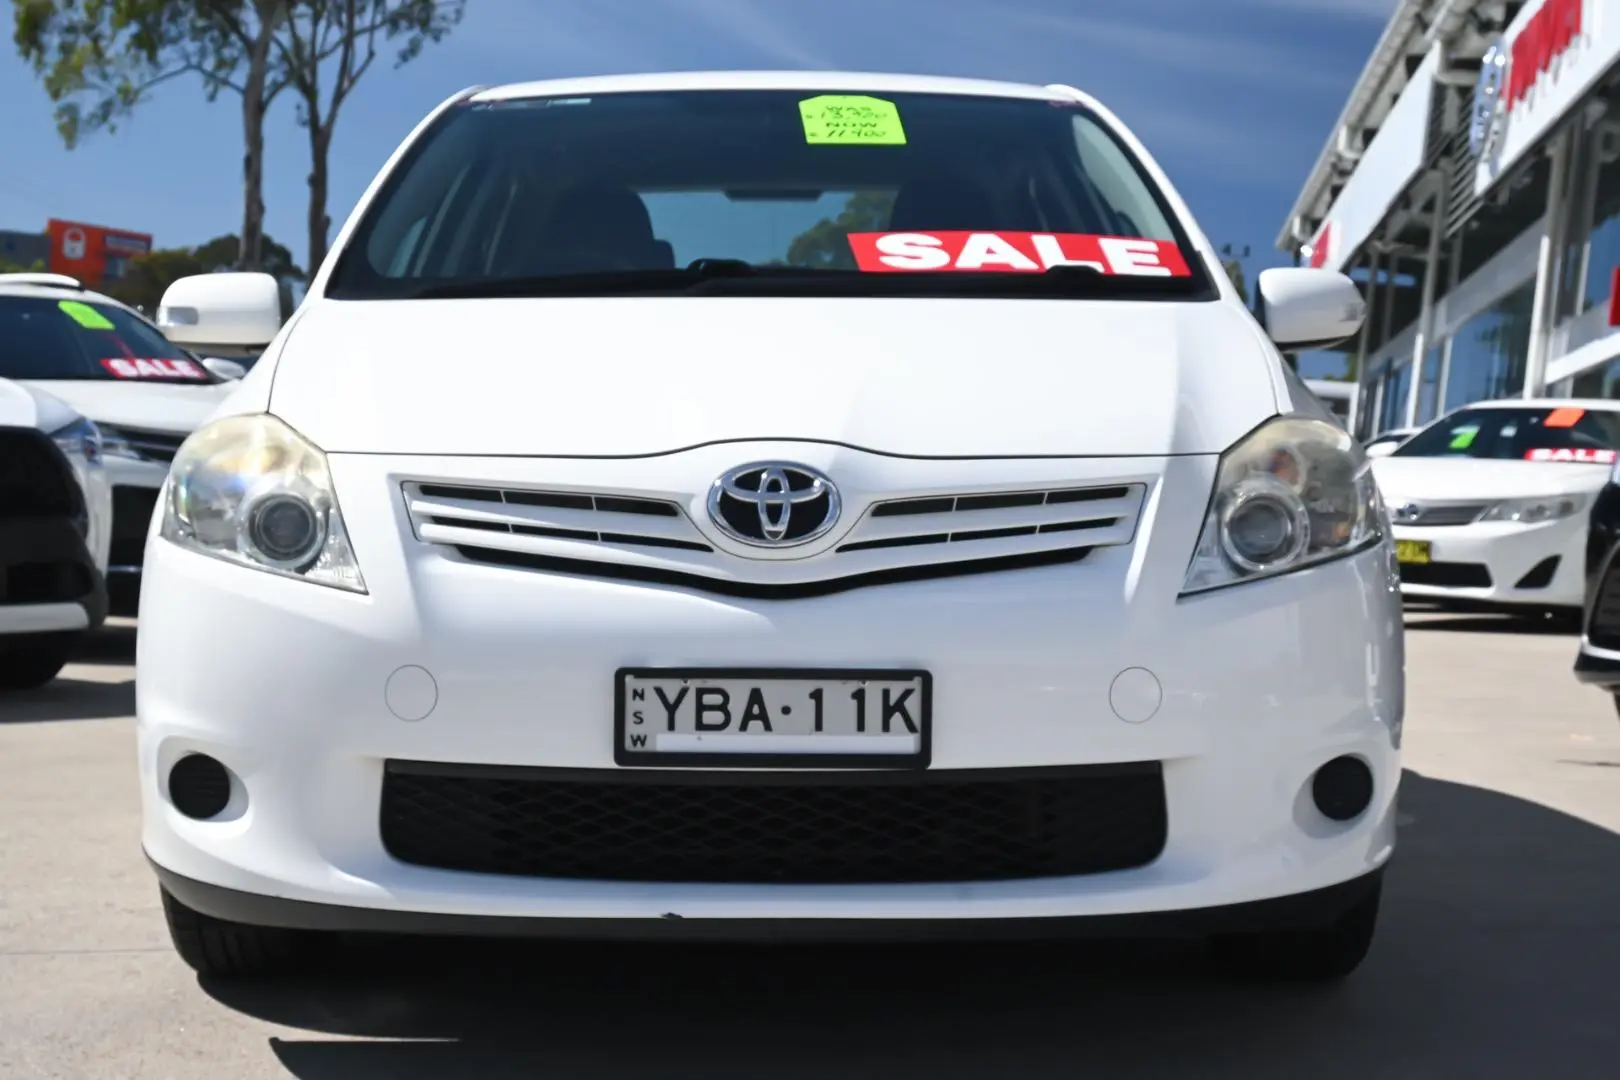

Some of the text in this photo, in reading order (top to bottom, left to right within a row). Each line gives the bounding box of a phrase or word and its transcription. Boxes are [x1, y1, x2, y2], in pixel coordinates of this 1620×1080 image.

[875, 233, 1172, 276] SALE
[108, 358, 202, 377] SALE
[1533, 448, 1611, 464] SALE
